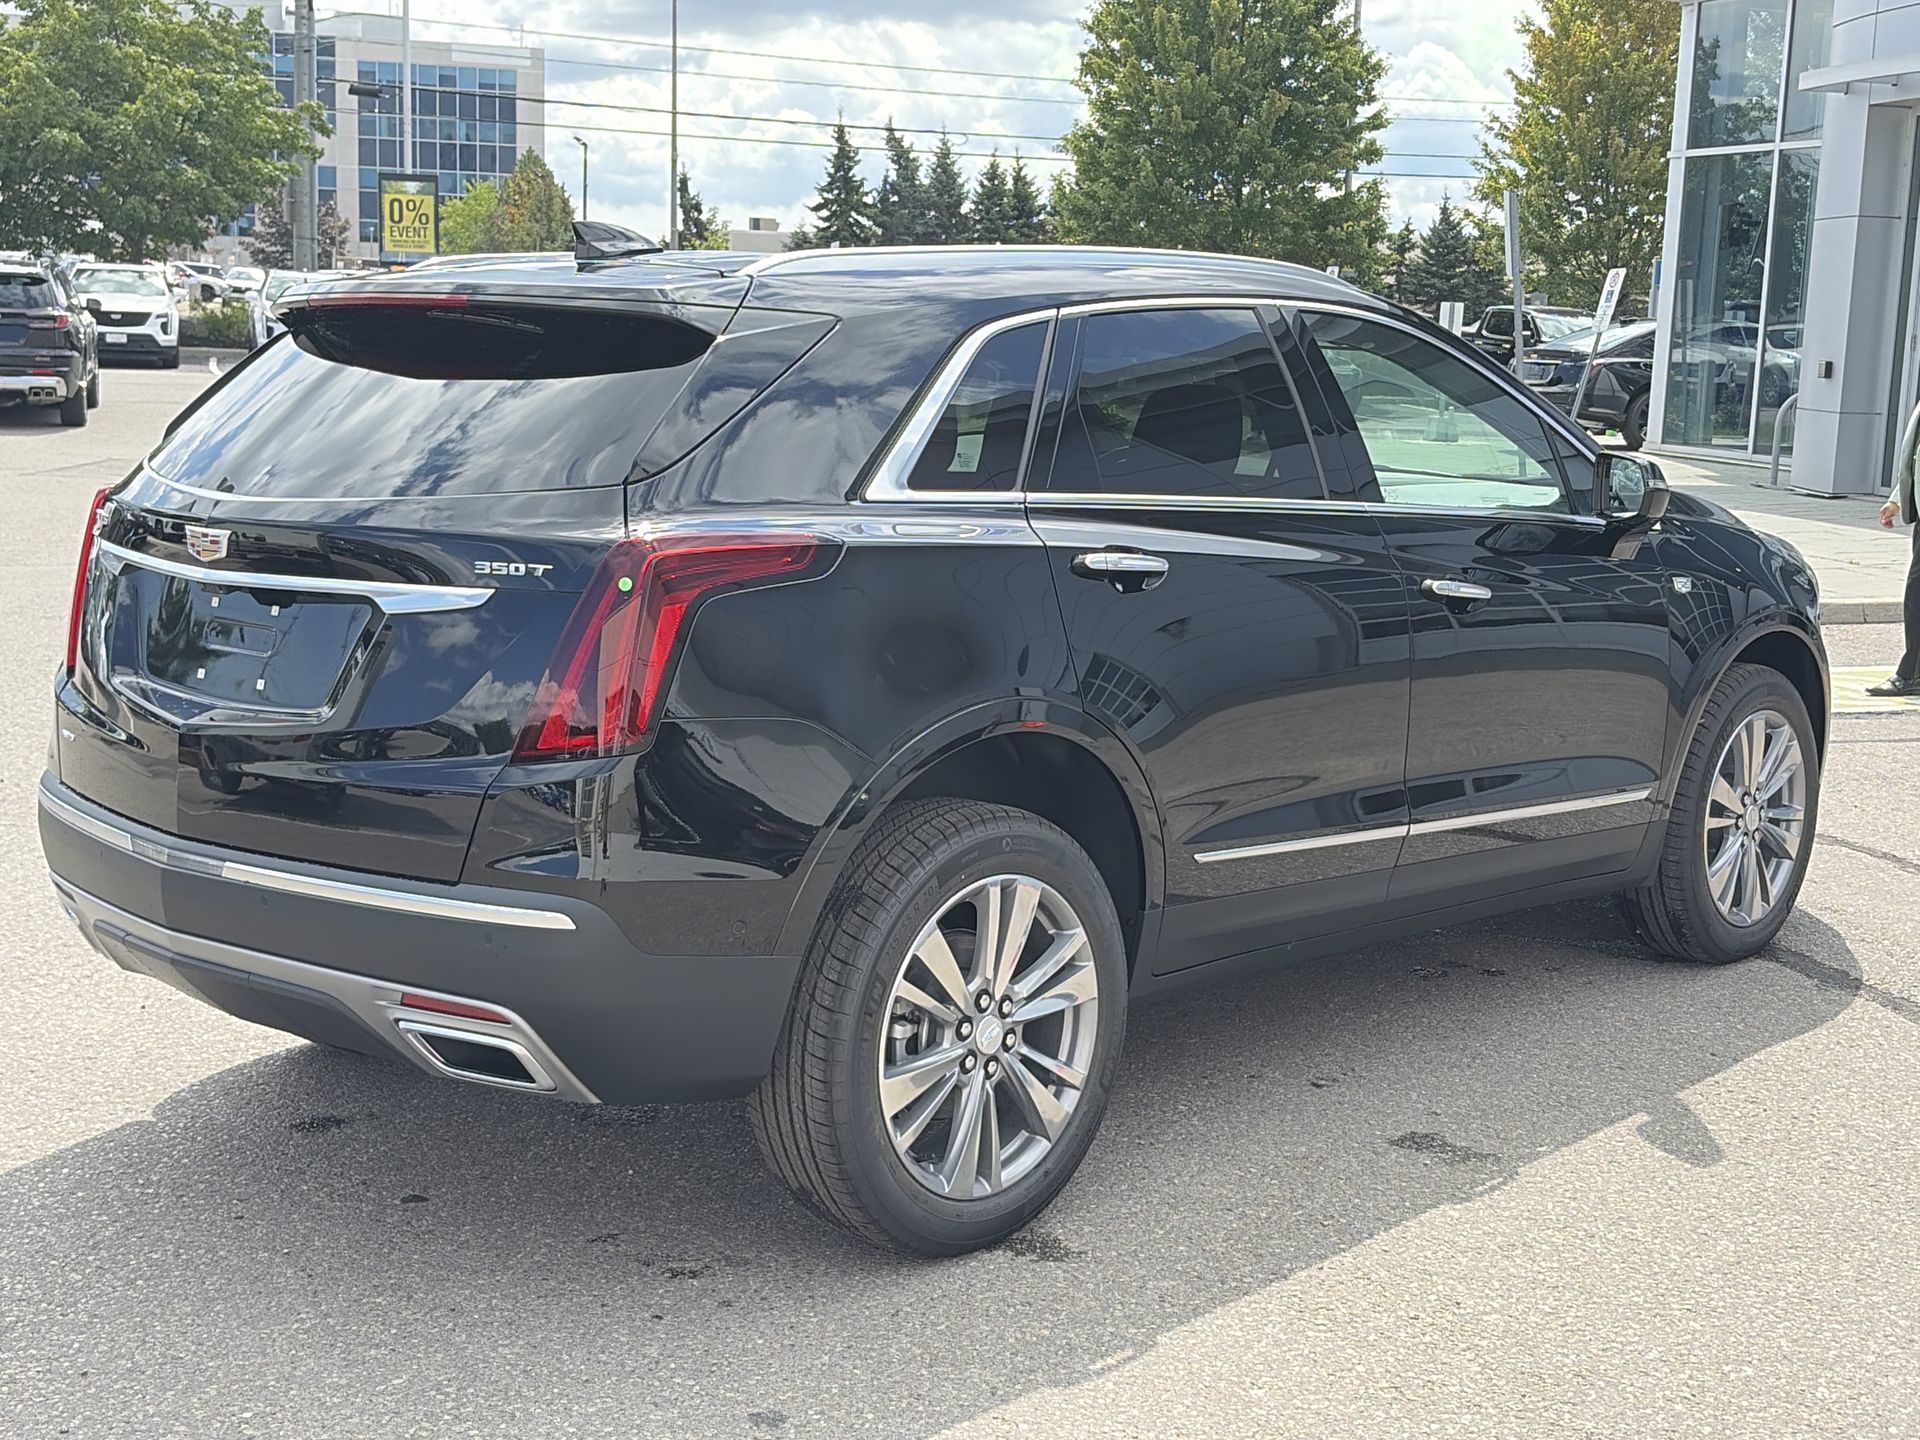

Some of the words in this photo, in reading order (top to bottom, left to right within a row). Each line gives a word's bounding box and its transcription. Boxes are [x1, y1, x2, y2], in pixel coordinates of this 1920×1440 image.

[389, 198, 430, 226] 0%
[389, 225, 429, 239] EVENT
[474, 561, 554, 577] 350T
